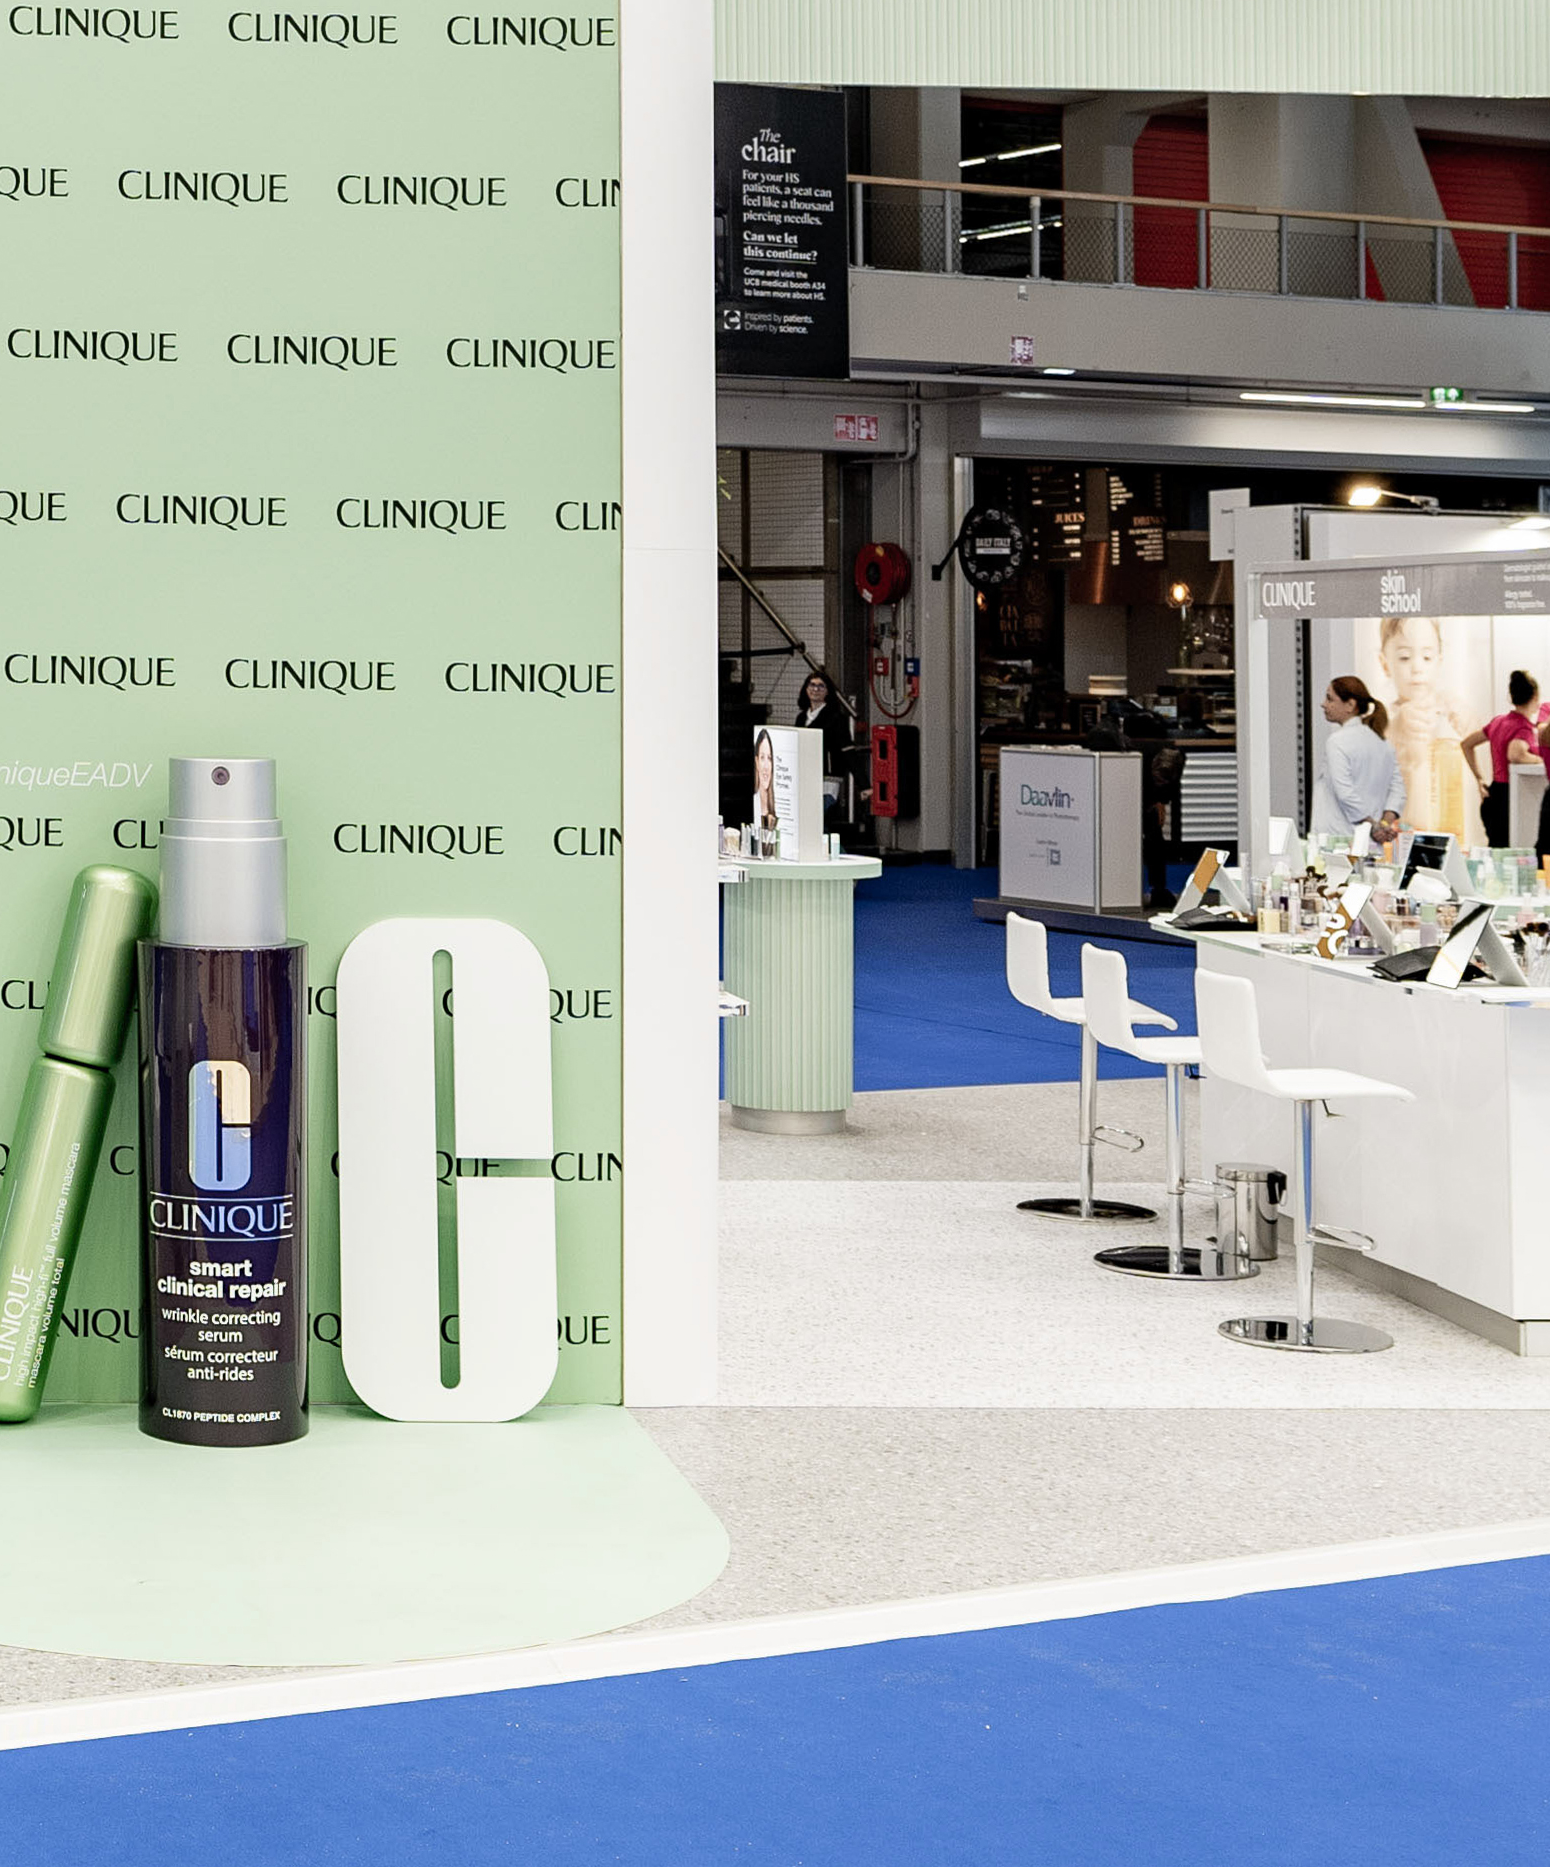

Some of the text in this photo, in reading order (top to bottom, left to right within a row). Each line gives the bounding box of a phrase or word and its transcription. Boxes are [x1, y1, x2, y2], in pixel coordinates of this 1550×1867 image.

[9, 6, 179, 44] CLINIQUE
[228, 12, 398, 49] CLINIQUE
[447, 16, 615, 52] CLINIQUE
[759, 128, 781, 143] The
[741, 137, 796, 164] chair
[742, 169, 800, 184] For your HS
[118, 170, 288, 208] CLINIQUE
[337, 175, 507, 211] CLINIQUE
[793, 187, 812, 196] seat
[813, 189, 832, 198] can
[742, 194, 834, 212] feel like a thousand
[743, 210, 782, 225] piercing
[743, 230, 798, 244] Can we let
[743, 246, 818, 261] this continue?
[7, 328, 178, 366] CLINIQUE
[227, 334, 397, 371] CLINIQUE
[446, 338, 616, 374] CLINIQUE
[116, 493, 287, 531] CLINIQUE
[336, 498, 506, 535] CLINIQUE
[1055, 513, 1085, 523] JUICES
[1381, 570, 1406, 595] skin
[1262, 581, 1316, 612] CLINIQUE
[1381, 591, 1421, 614] school
[4, 653, 176, 691] CLINIQUE
[225, 658, 396, 696] CLINIQUE
[445, 662, 615, 698] CLINIQUE
[1021, 784, 1071, 808] Daavlin
[333, 823, 504, 860] CLINIQUE
[150, 1200, 293, 1236] CLINIQUE
[14, 1141, 81, 1388] high impact full volume mascara
[190, 1258, 252, 1278] smart
[157, 1277, 286, 1302] clinical repair
[27, 1257, 65, 1389] mascara volume total
[162, 1308, 281, 1326] wrinkle correcting
[198, 1330, 242, 1343] serum
[164, 1345, 278, 1364] sérum correcteur
[187, 1366, 254, 1382] anti-rides
[163, 1407, 280, 1423] CL1870 PEPTIDE COMPLEX
